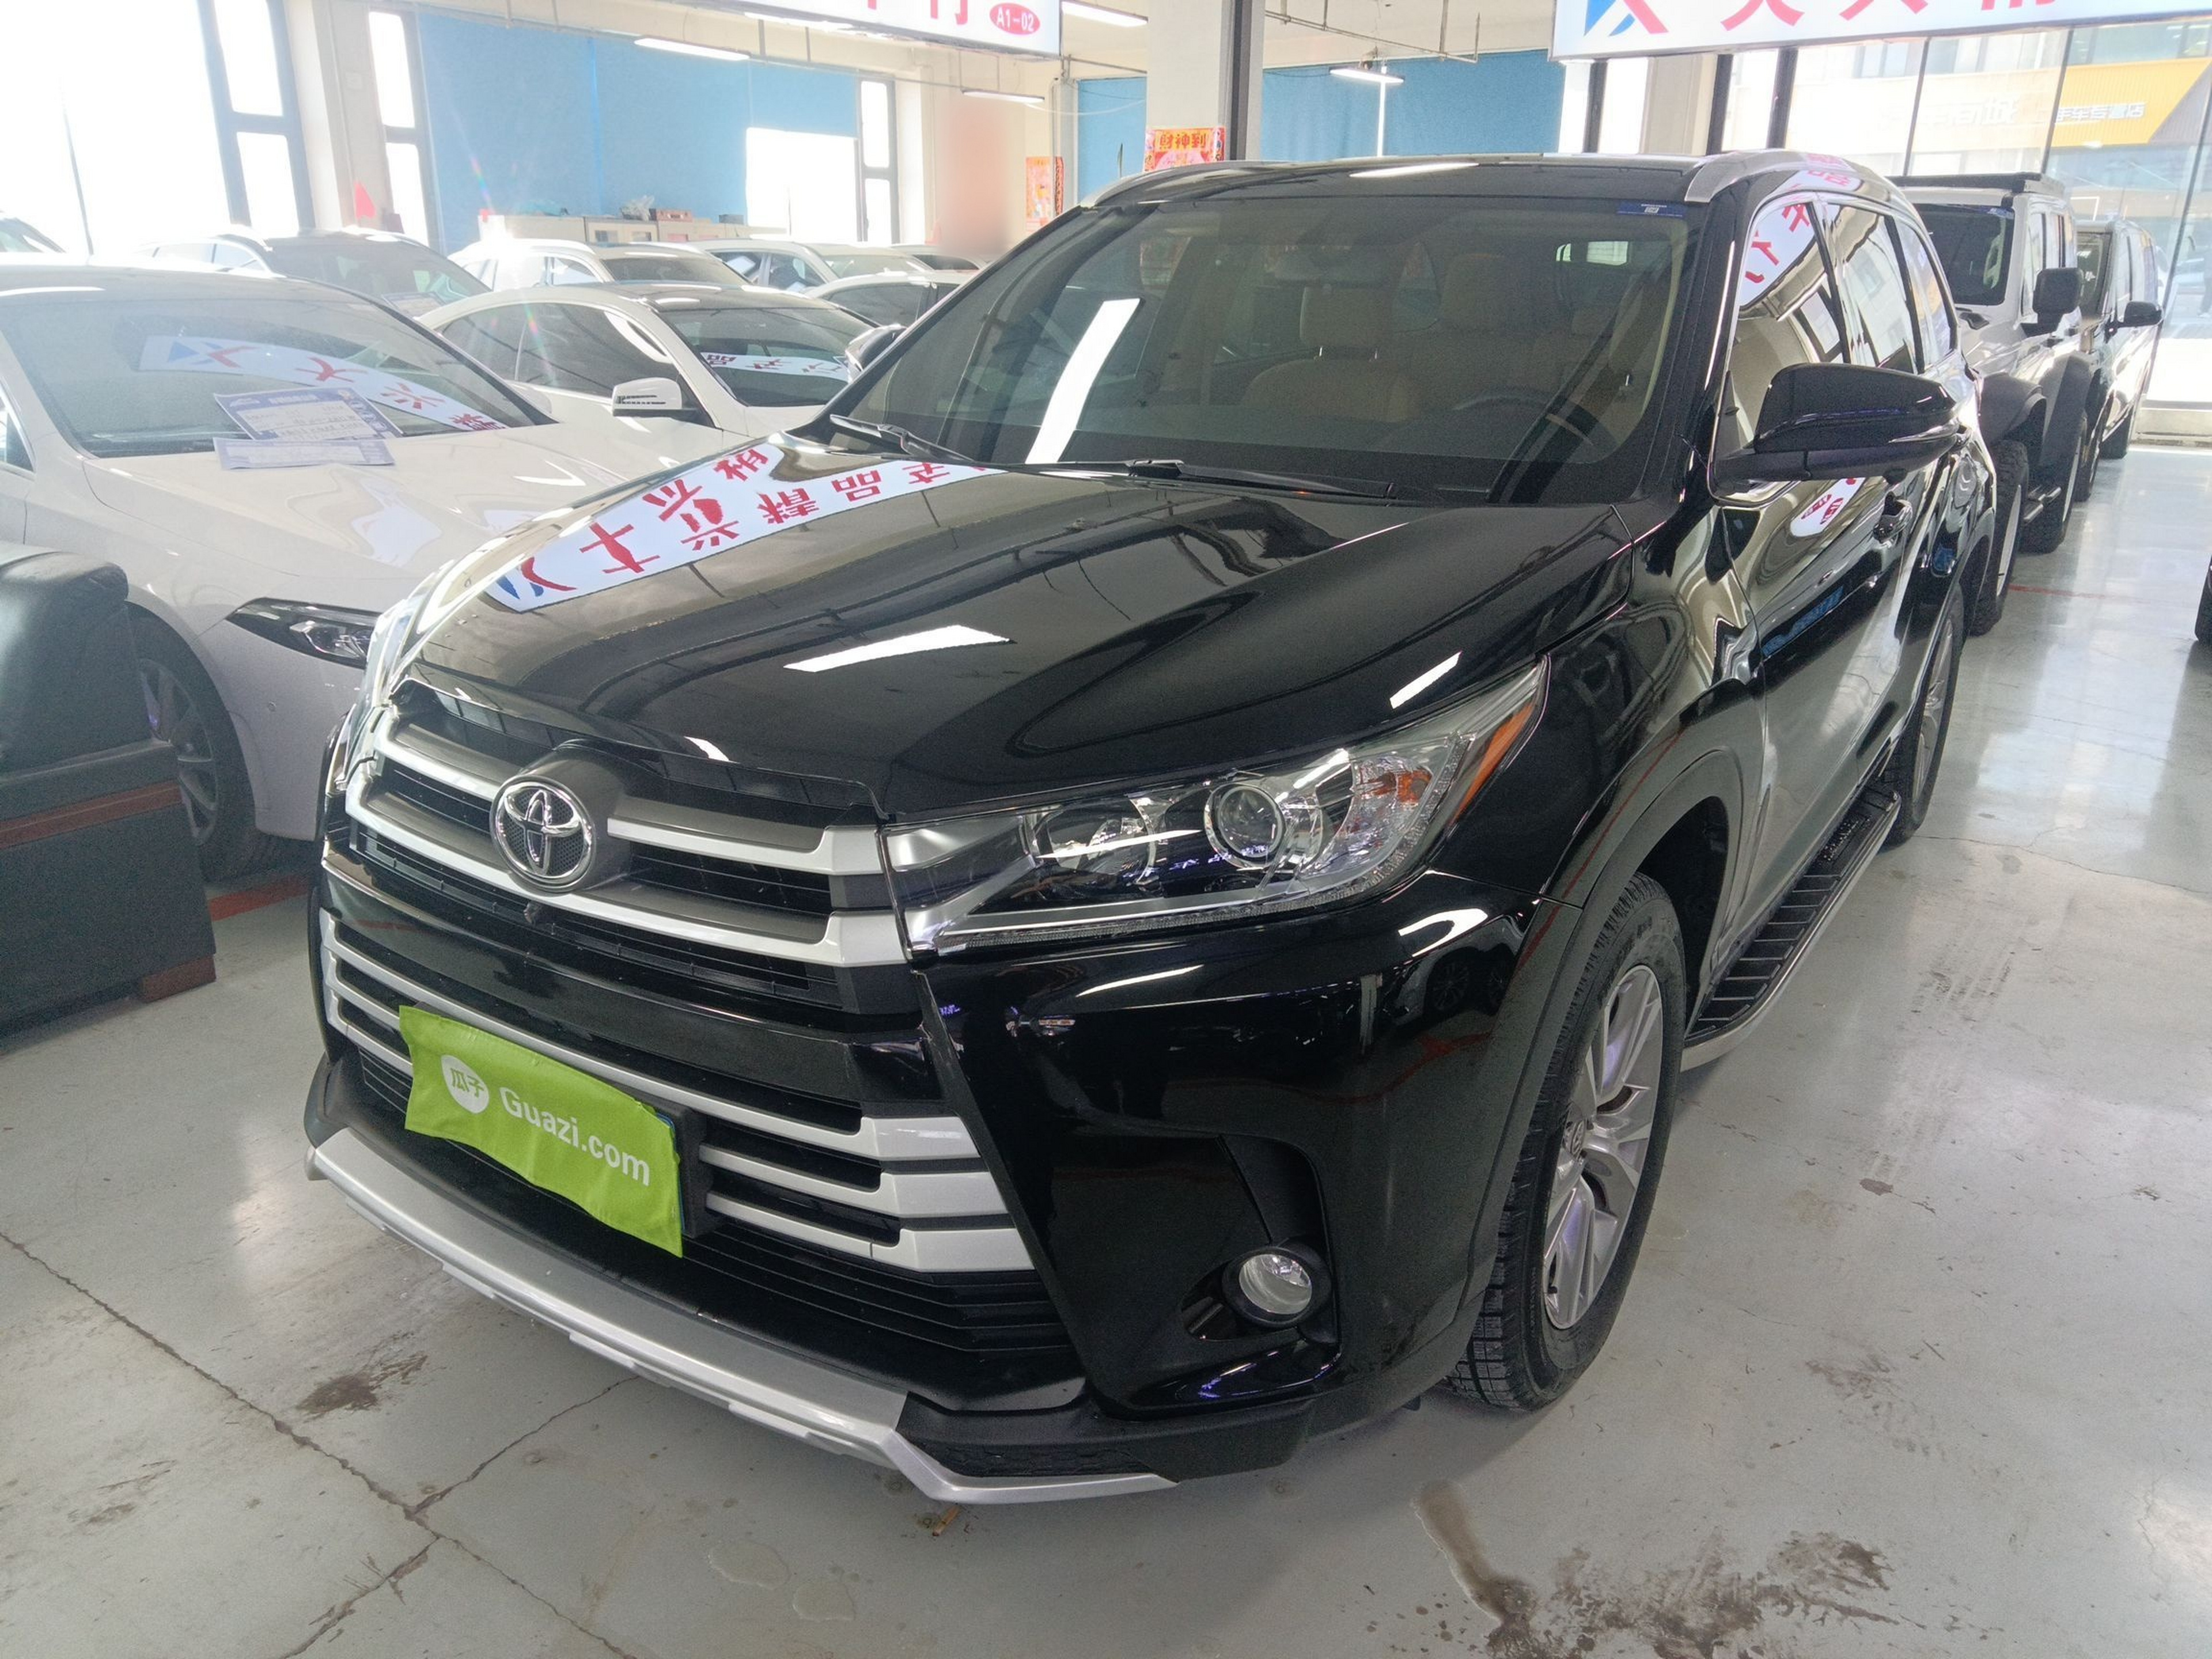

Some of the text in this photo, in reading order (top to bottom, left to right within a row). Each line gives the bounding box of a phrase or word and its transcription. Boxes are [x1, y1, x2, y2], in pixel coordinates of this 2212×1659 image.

[996, 6, 1036, 32] A1-02
[450, 1069, 651, 1187] 瓜子 Guazi.com
